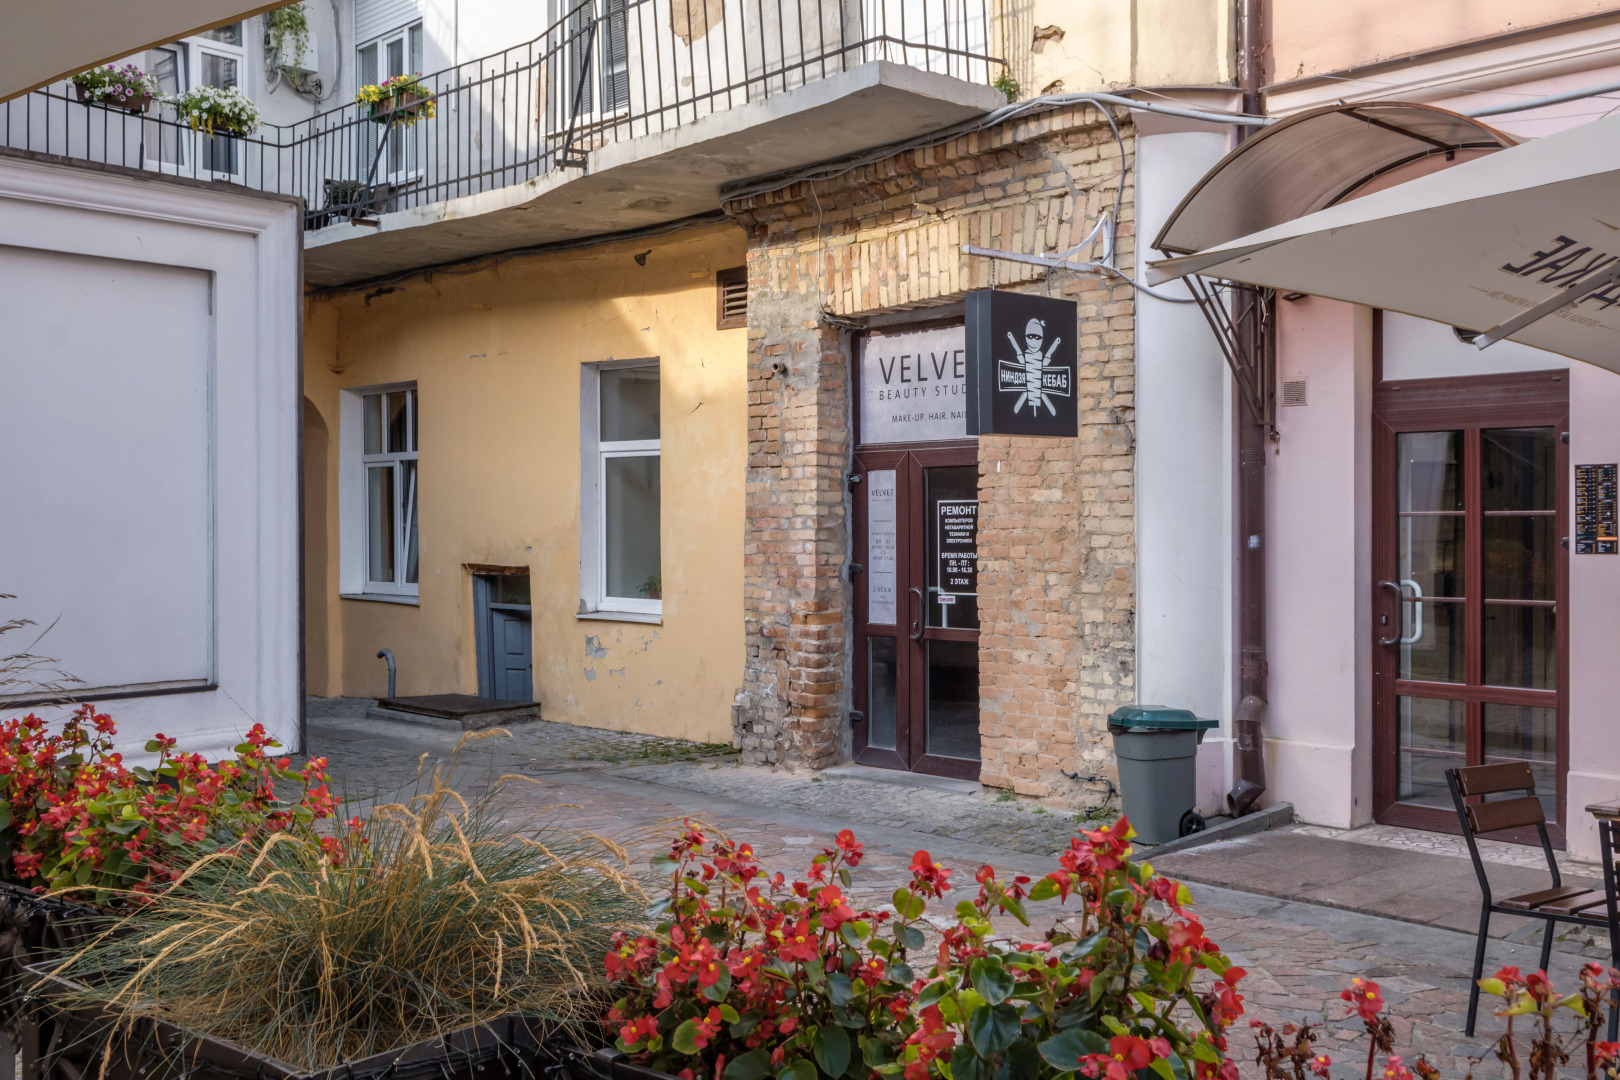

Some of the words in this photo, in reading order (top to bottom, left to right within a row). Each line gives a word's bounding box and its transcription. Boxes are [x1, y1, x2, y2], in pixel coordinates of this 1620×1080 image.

[1001, 369, 1026, 384] НИНДЗЯ
[1043, 373, 1067, 388] КЕБАБ
[879, 386, 927, 401] BEAUTY
[891, 413, 927, 423] MAKE-UP.
[928, 412, 948, 421] HAIR.
[871, 488, 894, 497] VELVET
[941, 505, 977, 516] РЕМОНТ
